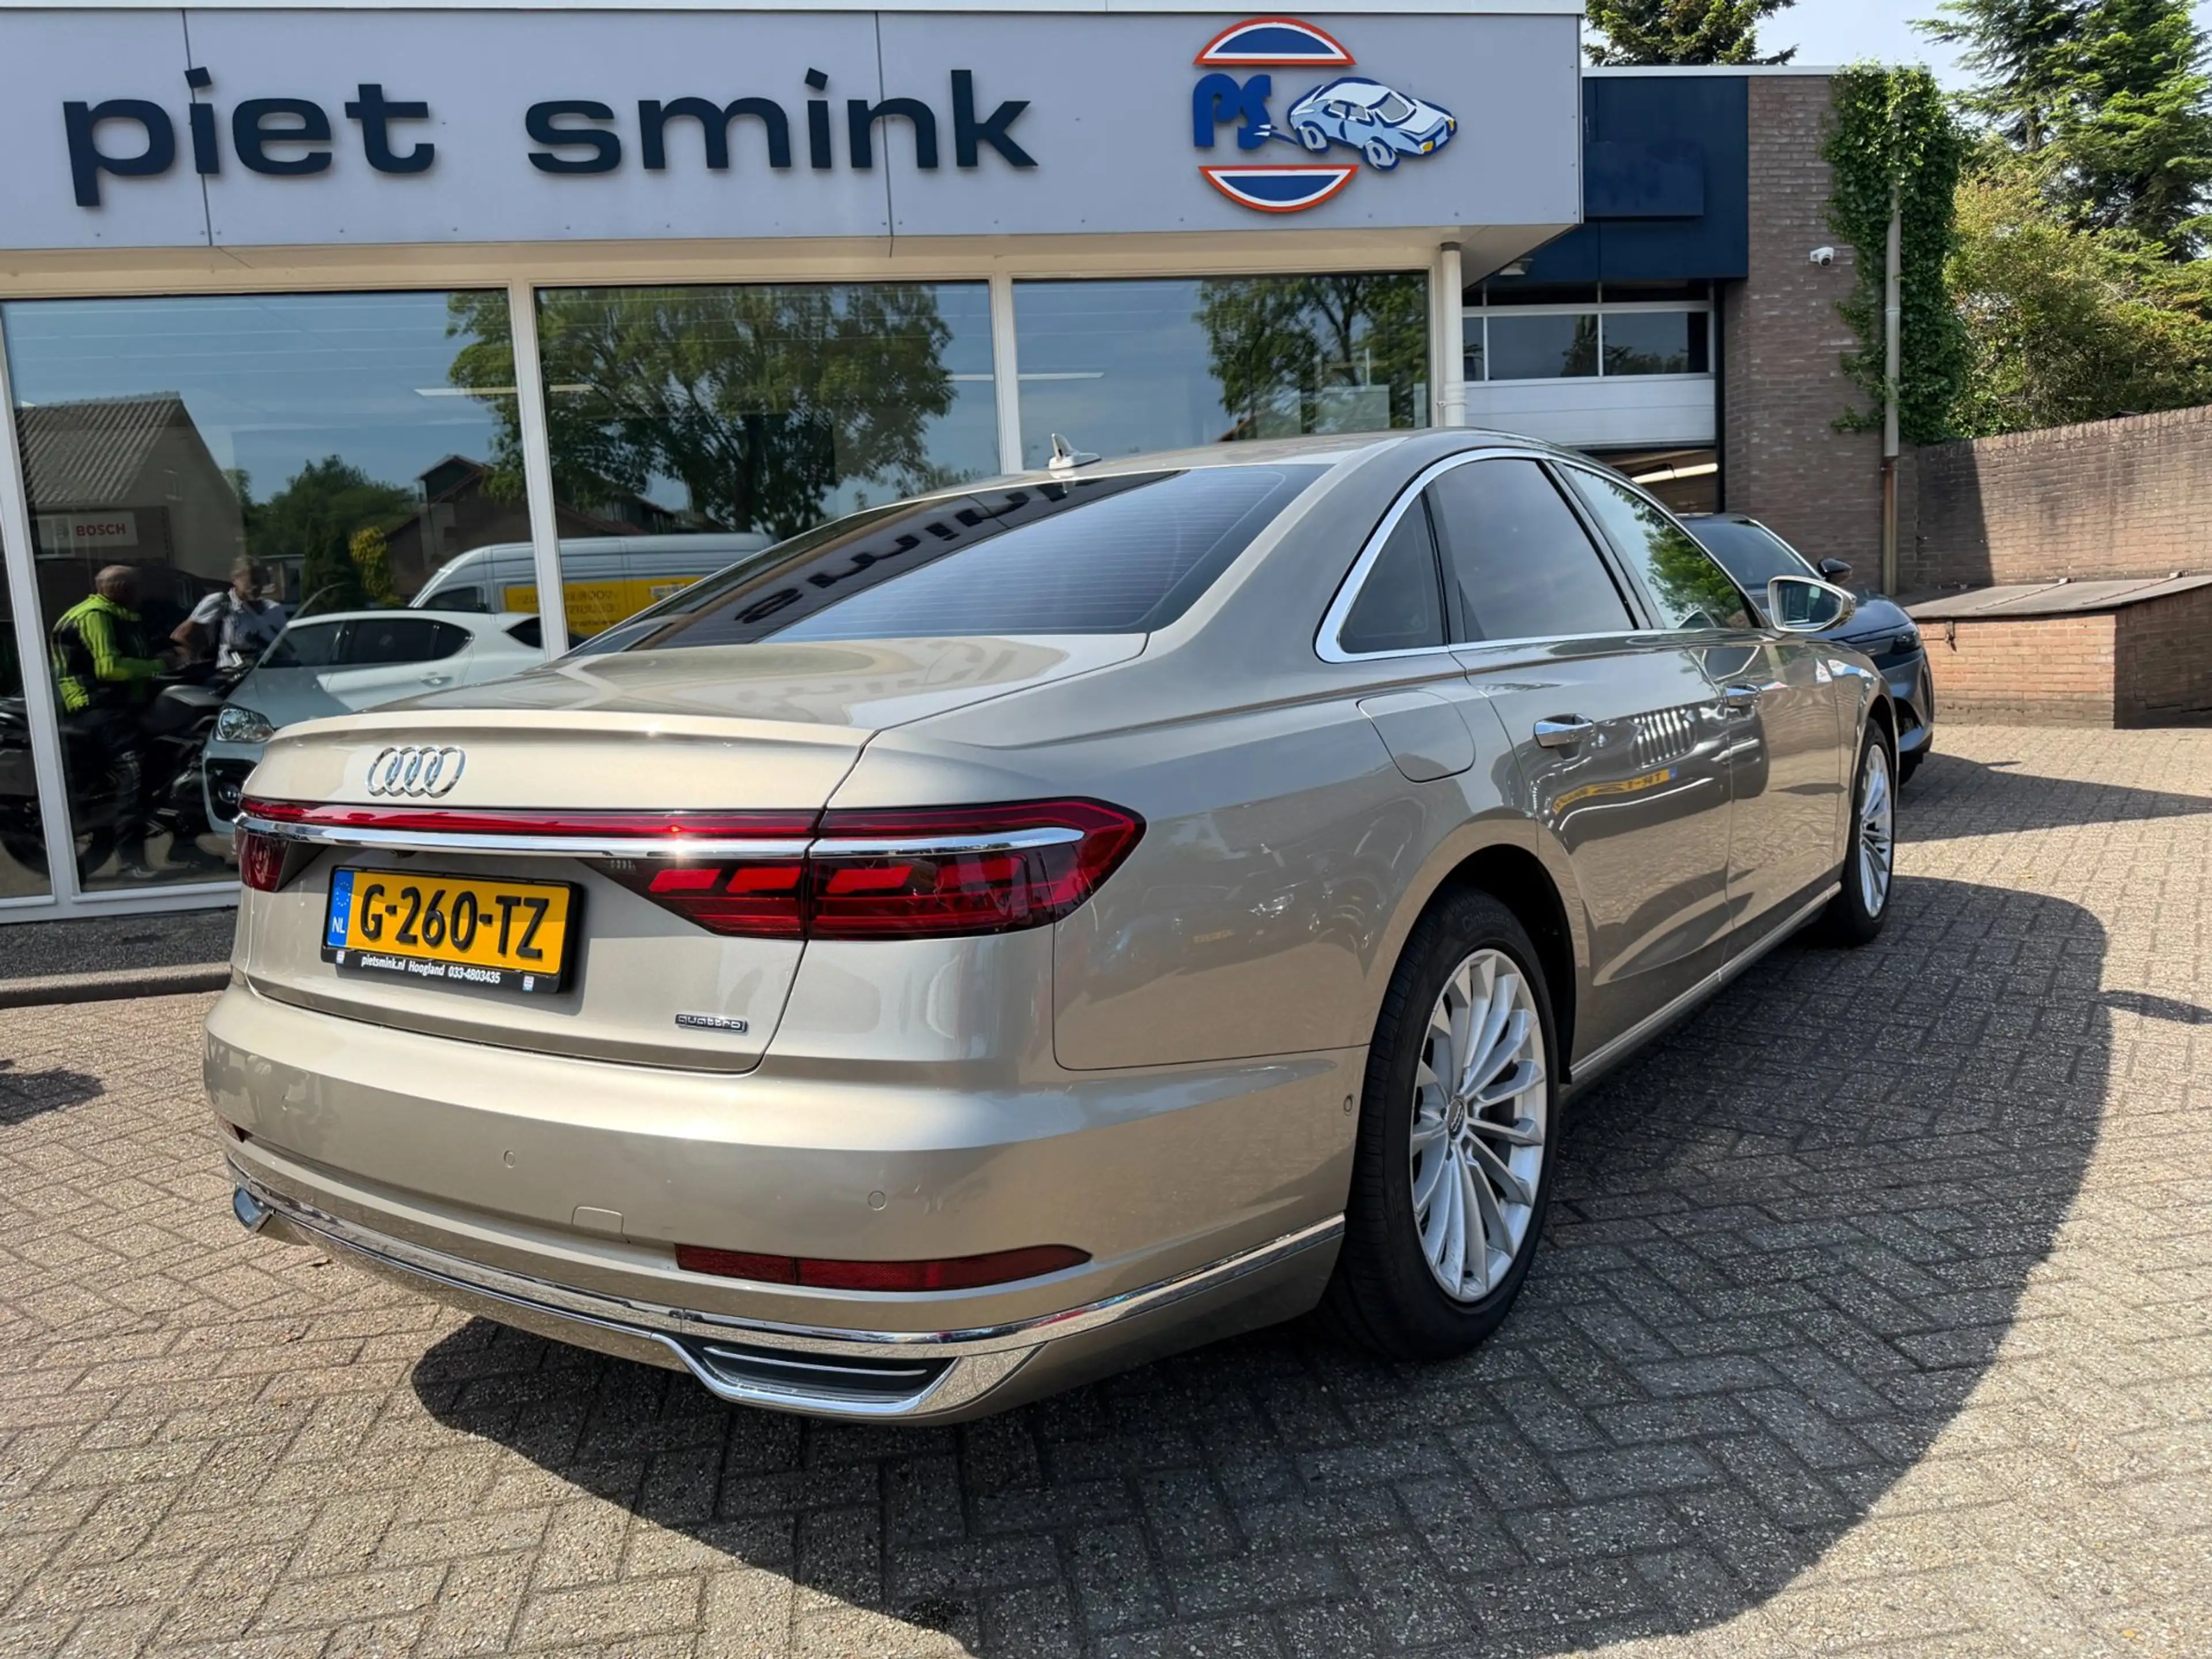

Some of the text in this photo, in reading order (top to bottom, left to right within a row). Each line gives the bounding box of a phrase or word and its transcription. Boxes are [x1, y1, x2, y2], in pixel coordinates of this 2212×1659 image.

[63, 66, 1039, 206] piet smink
[75, 522, 127, 537] BOSCH
[331, 916, 346, 934] NL
[360, 883, 550, 959] G-260-TZ
[361, 955, 501, 984] pietsmink.nl Hoogland 033-4803435
[677, 1014, 741, 1029] quattro
